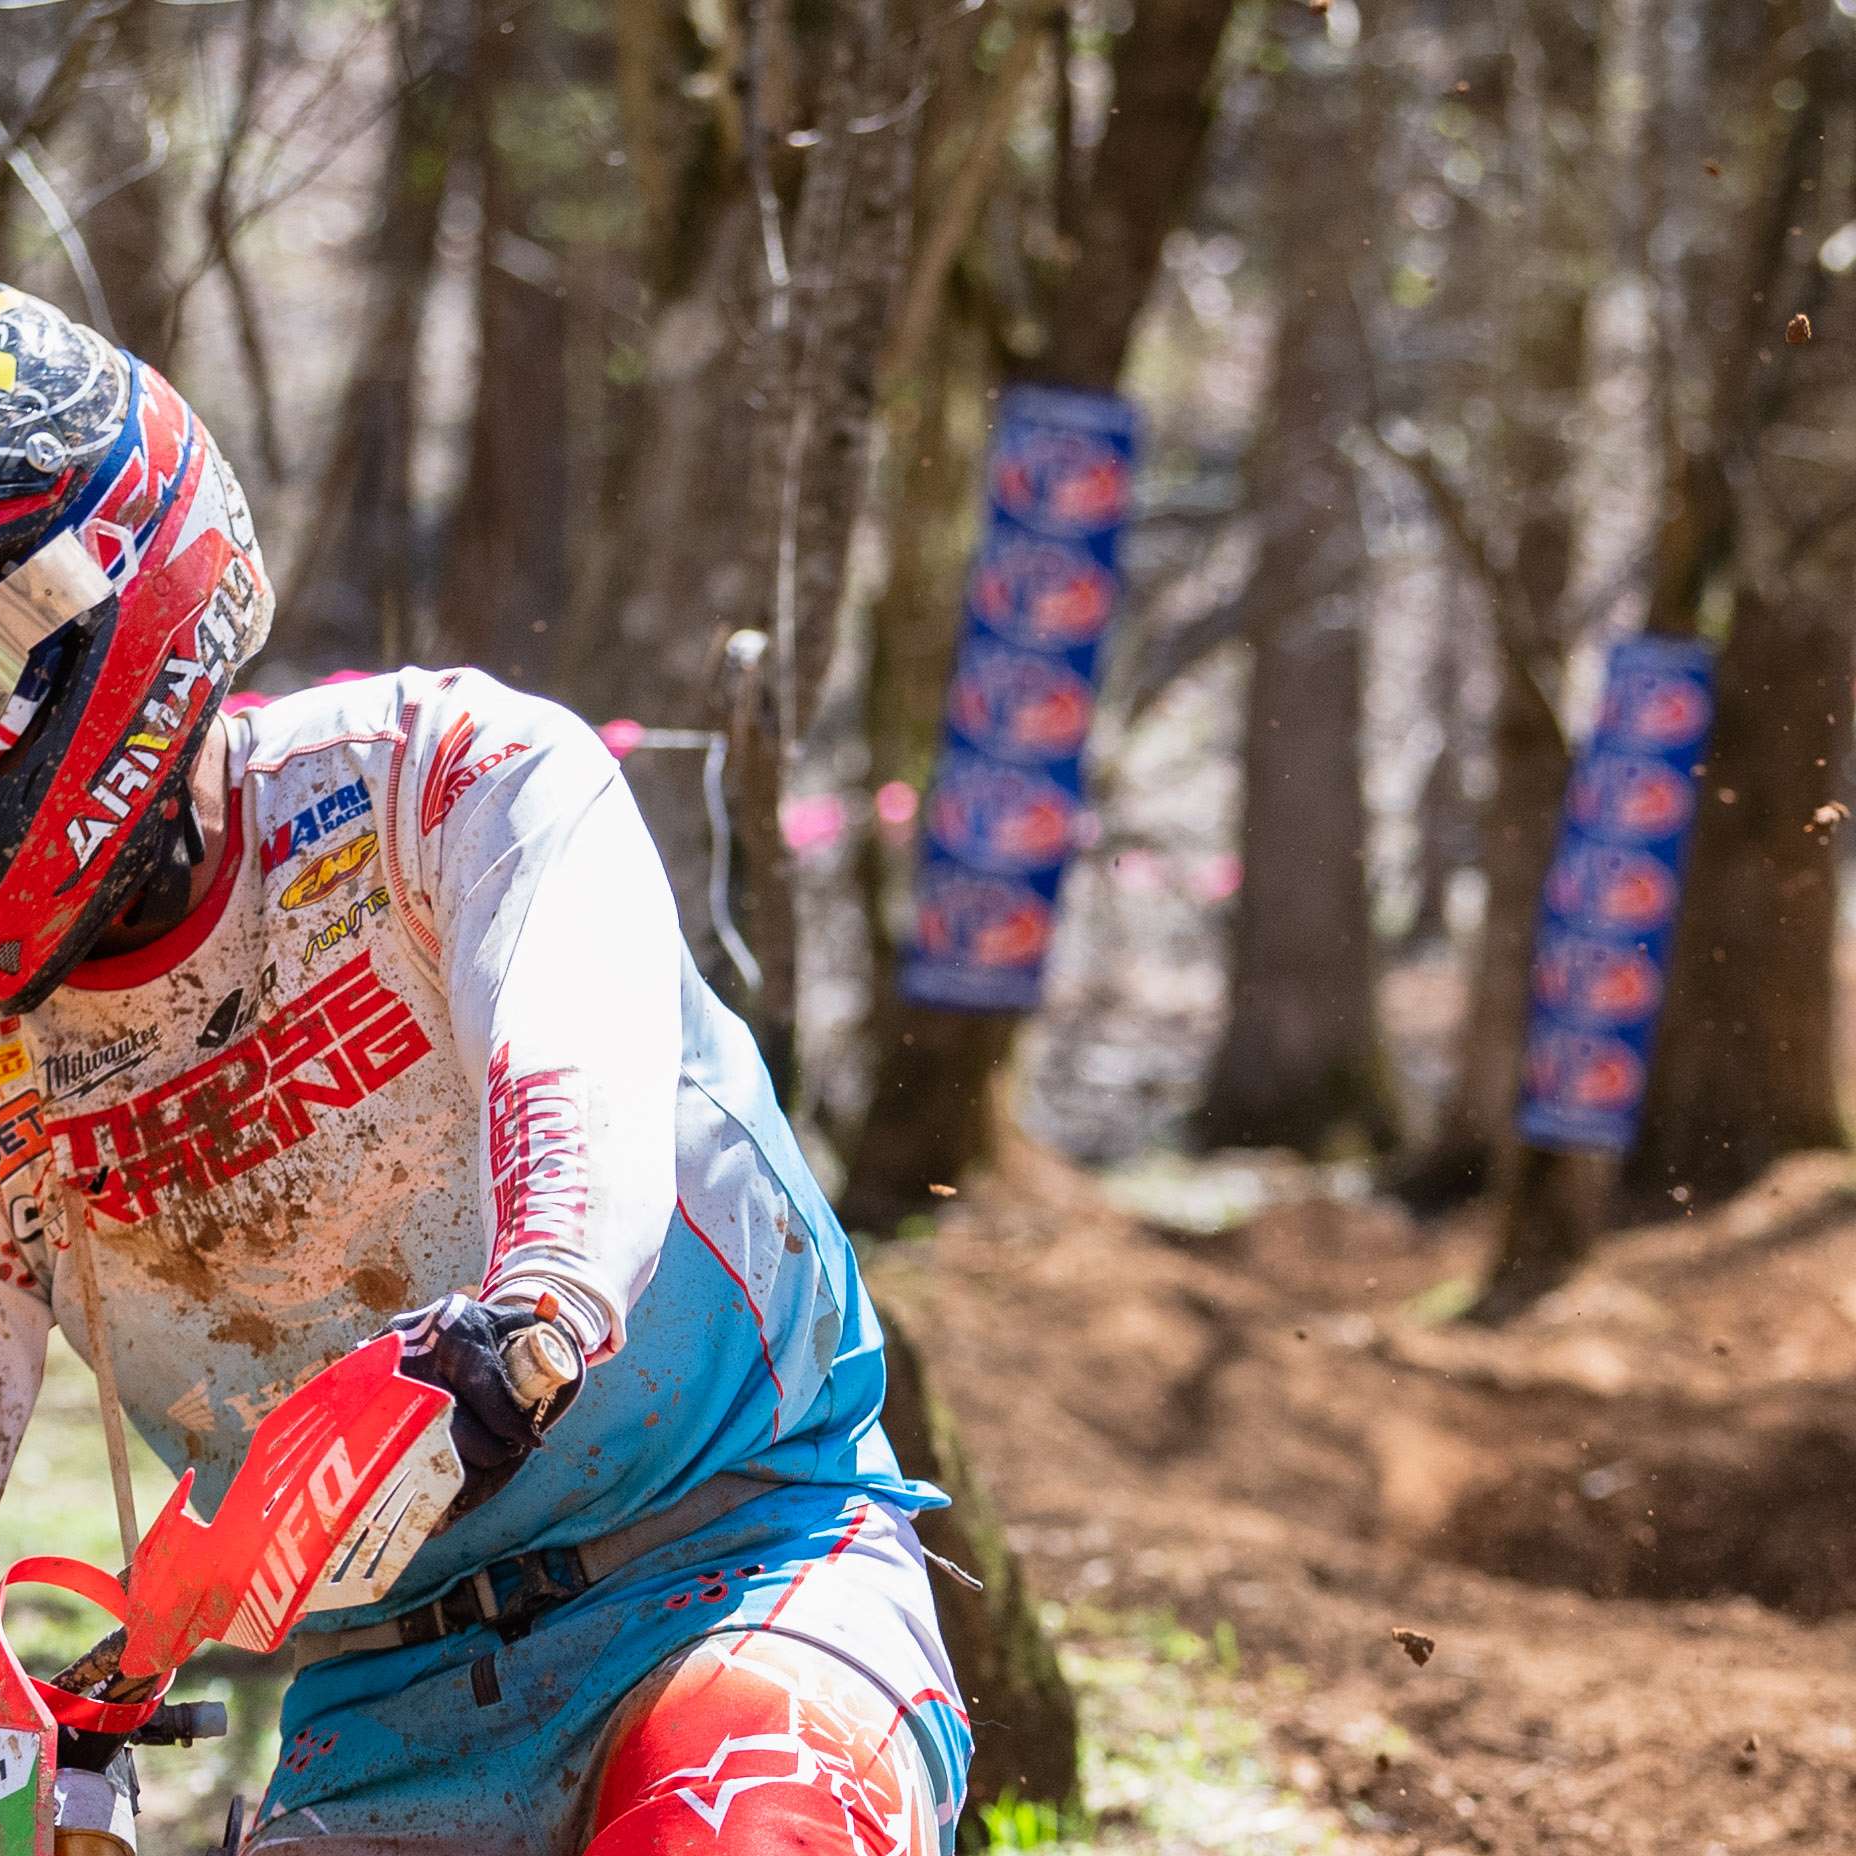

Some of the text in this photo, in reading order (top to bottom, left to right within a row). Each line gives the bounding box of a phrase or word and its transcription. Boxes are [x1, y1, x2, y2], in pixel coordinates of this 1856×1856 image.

[281, 833, 379, 909] FMF
[37, 1020, 165, 1092] Milwaukee
[516, 1076, 588, 1244] MOTUL
[249, 1435, 359, 1629] UFO
